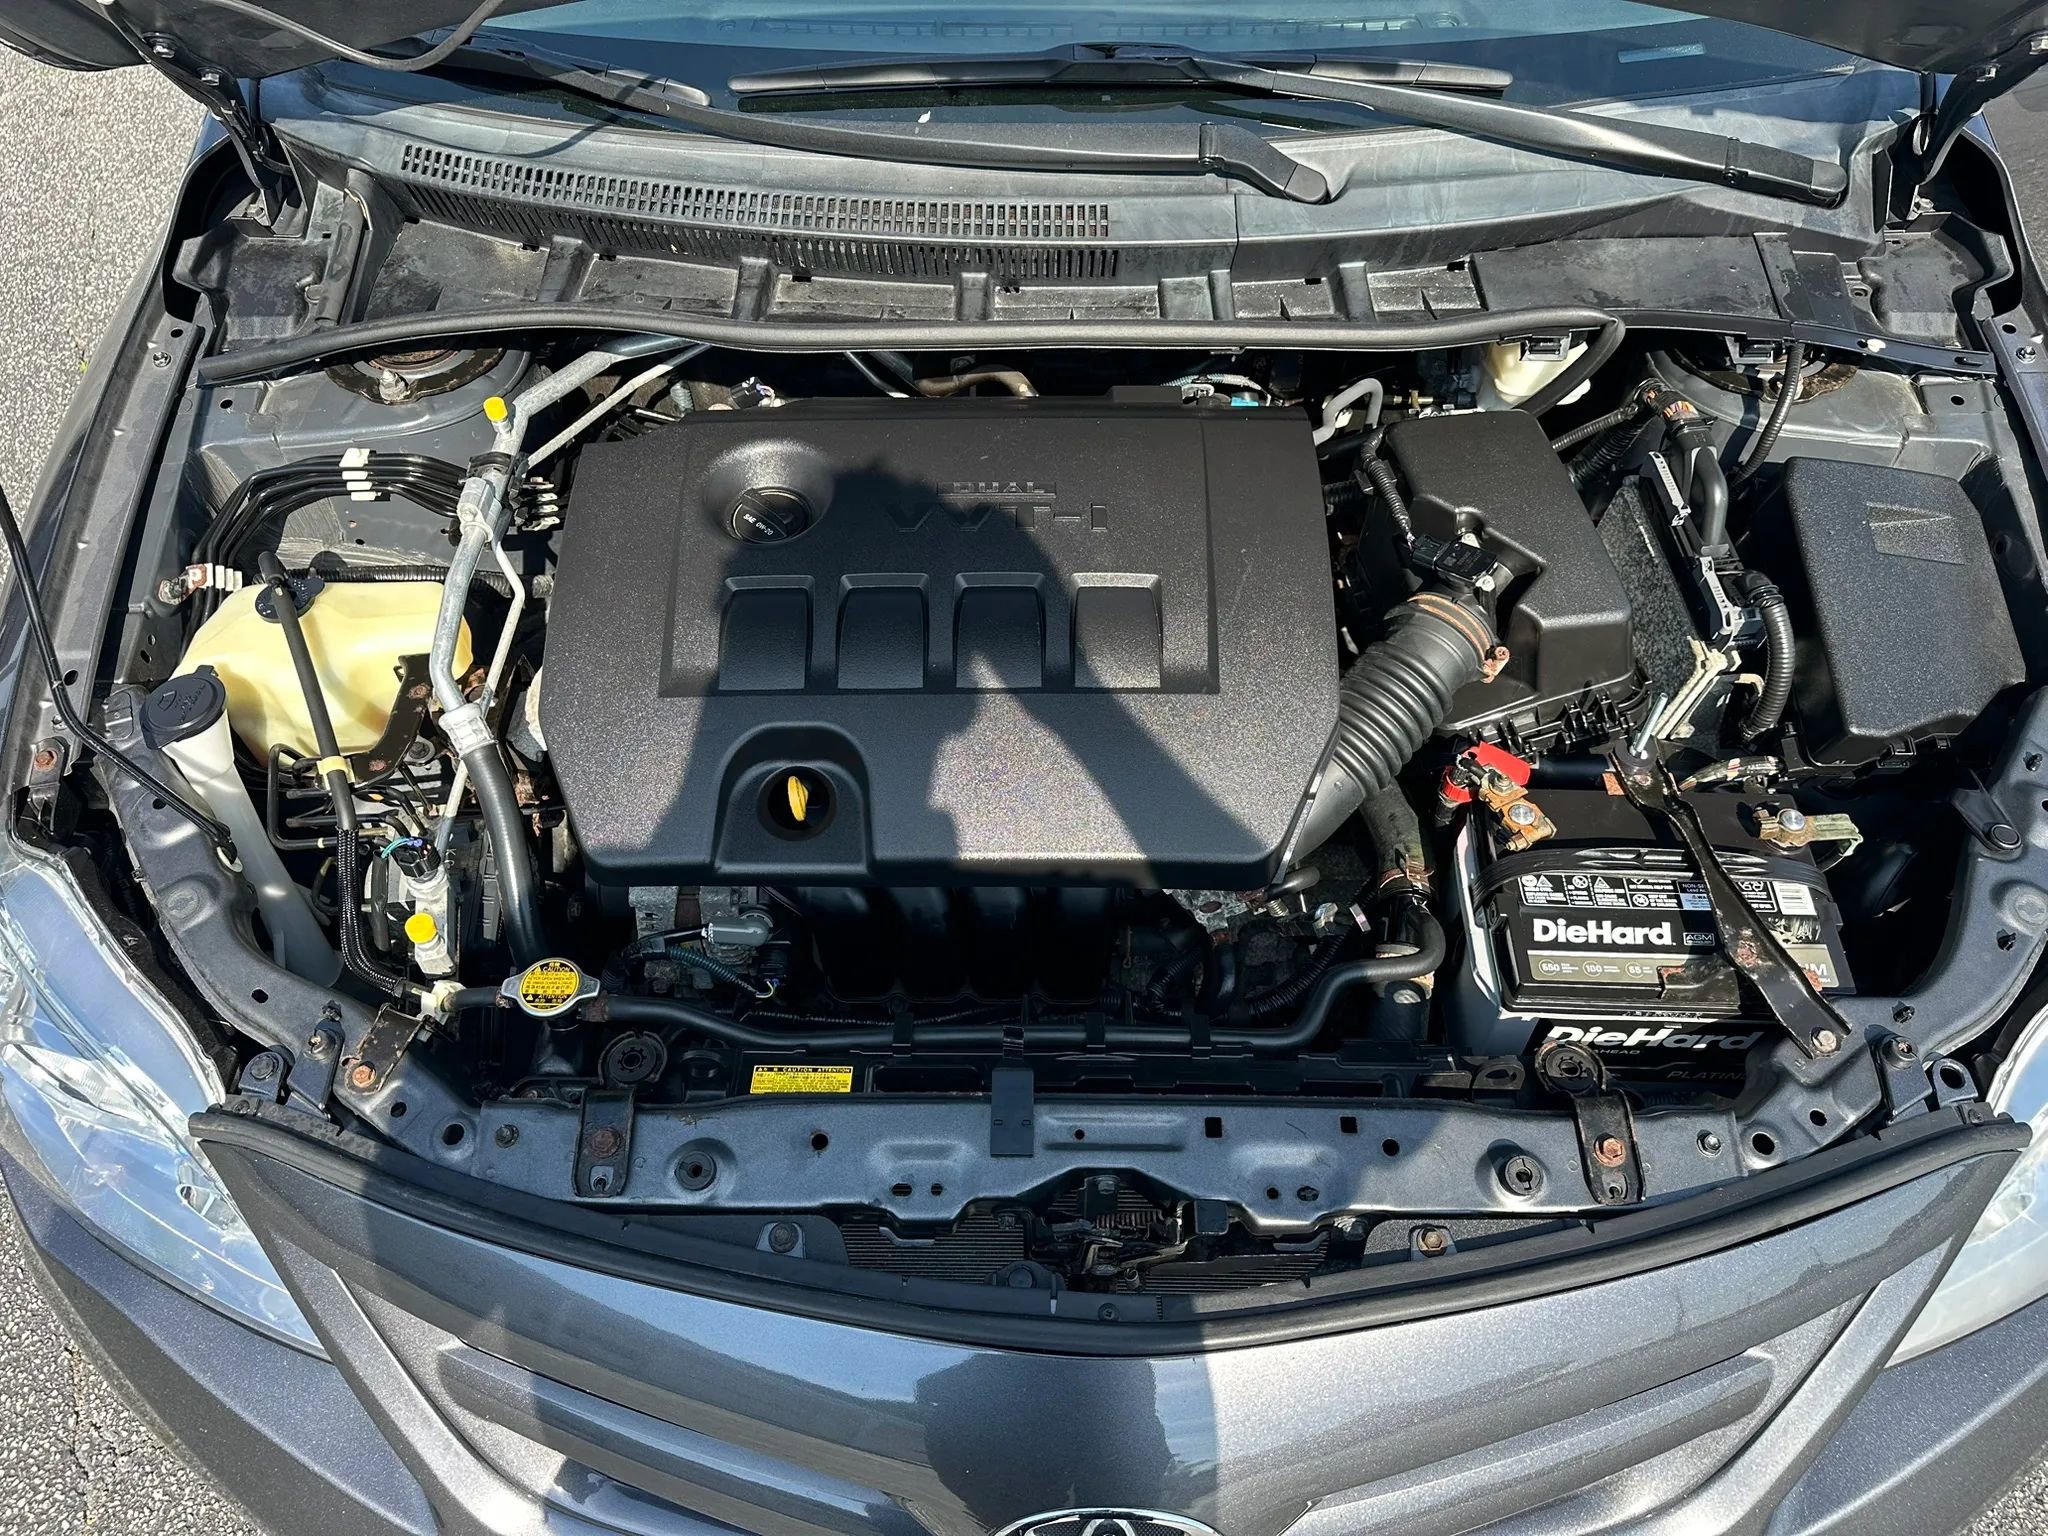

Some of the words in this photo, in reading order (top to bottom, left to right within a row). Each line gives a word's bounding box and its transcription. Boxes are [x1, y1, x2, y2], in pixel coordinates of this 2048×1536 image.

[952, 481, 1046, 493] DUAL
[743, 513, 757, 524] SAE
[1585, 964, 1602, 973] 100
[1542, 1025, 1764, 1050] DieHard
